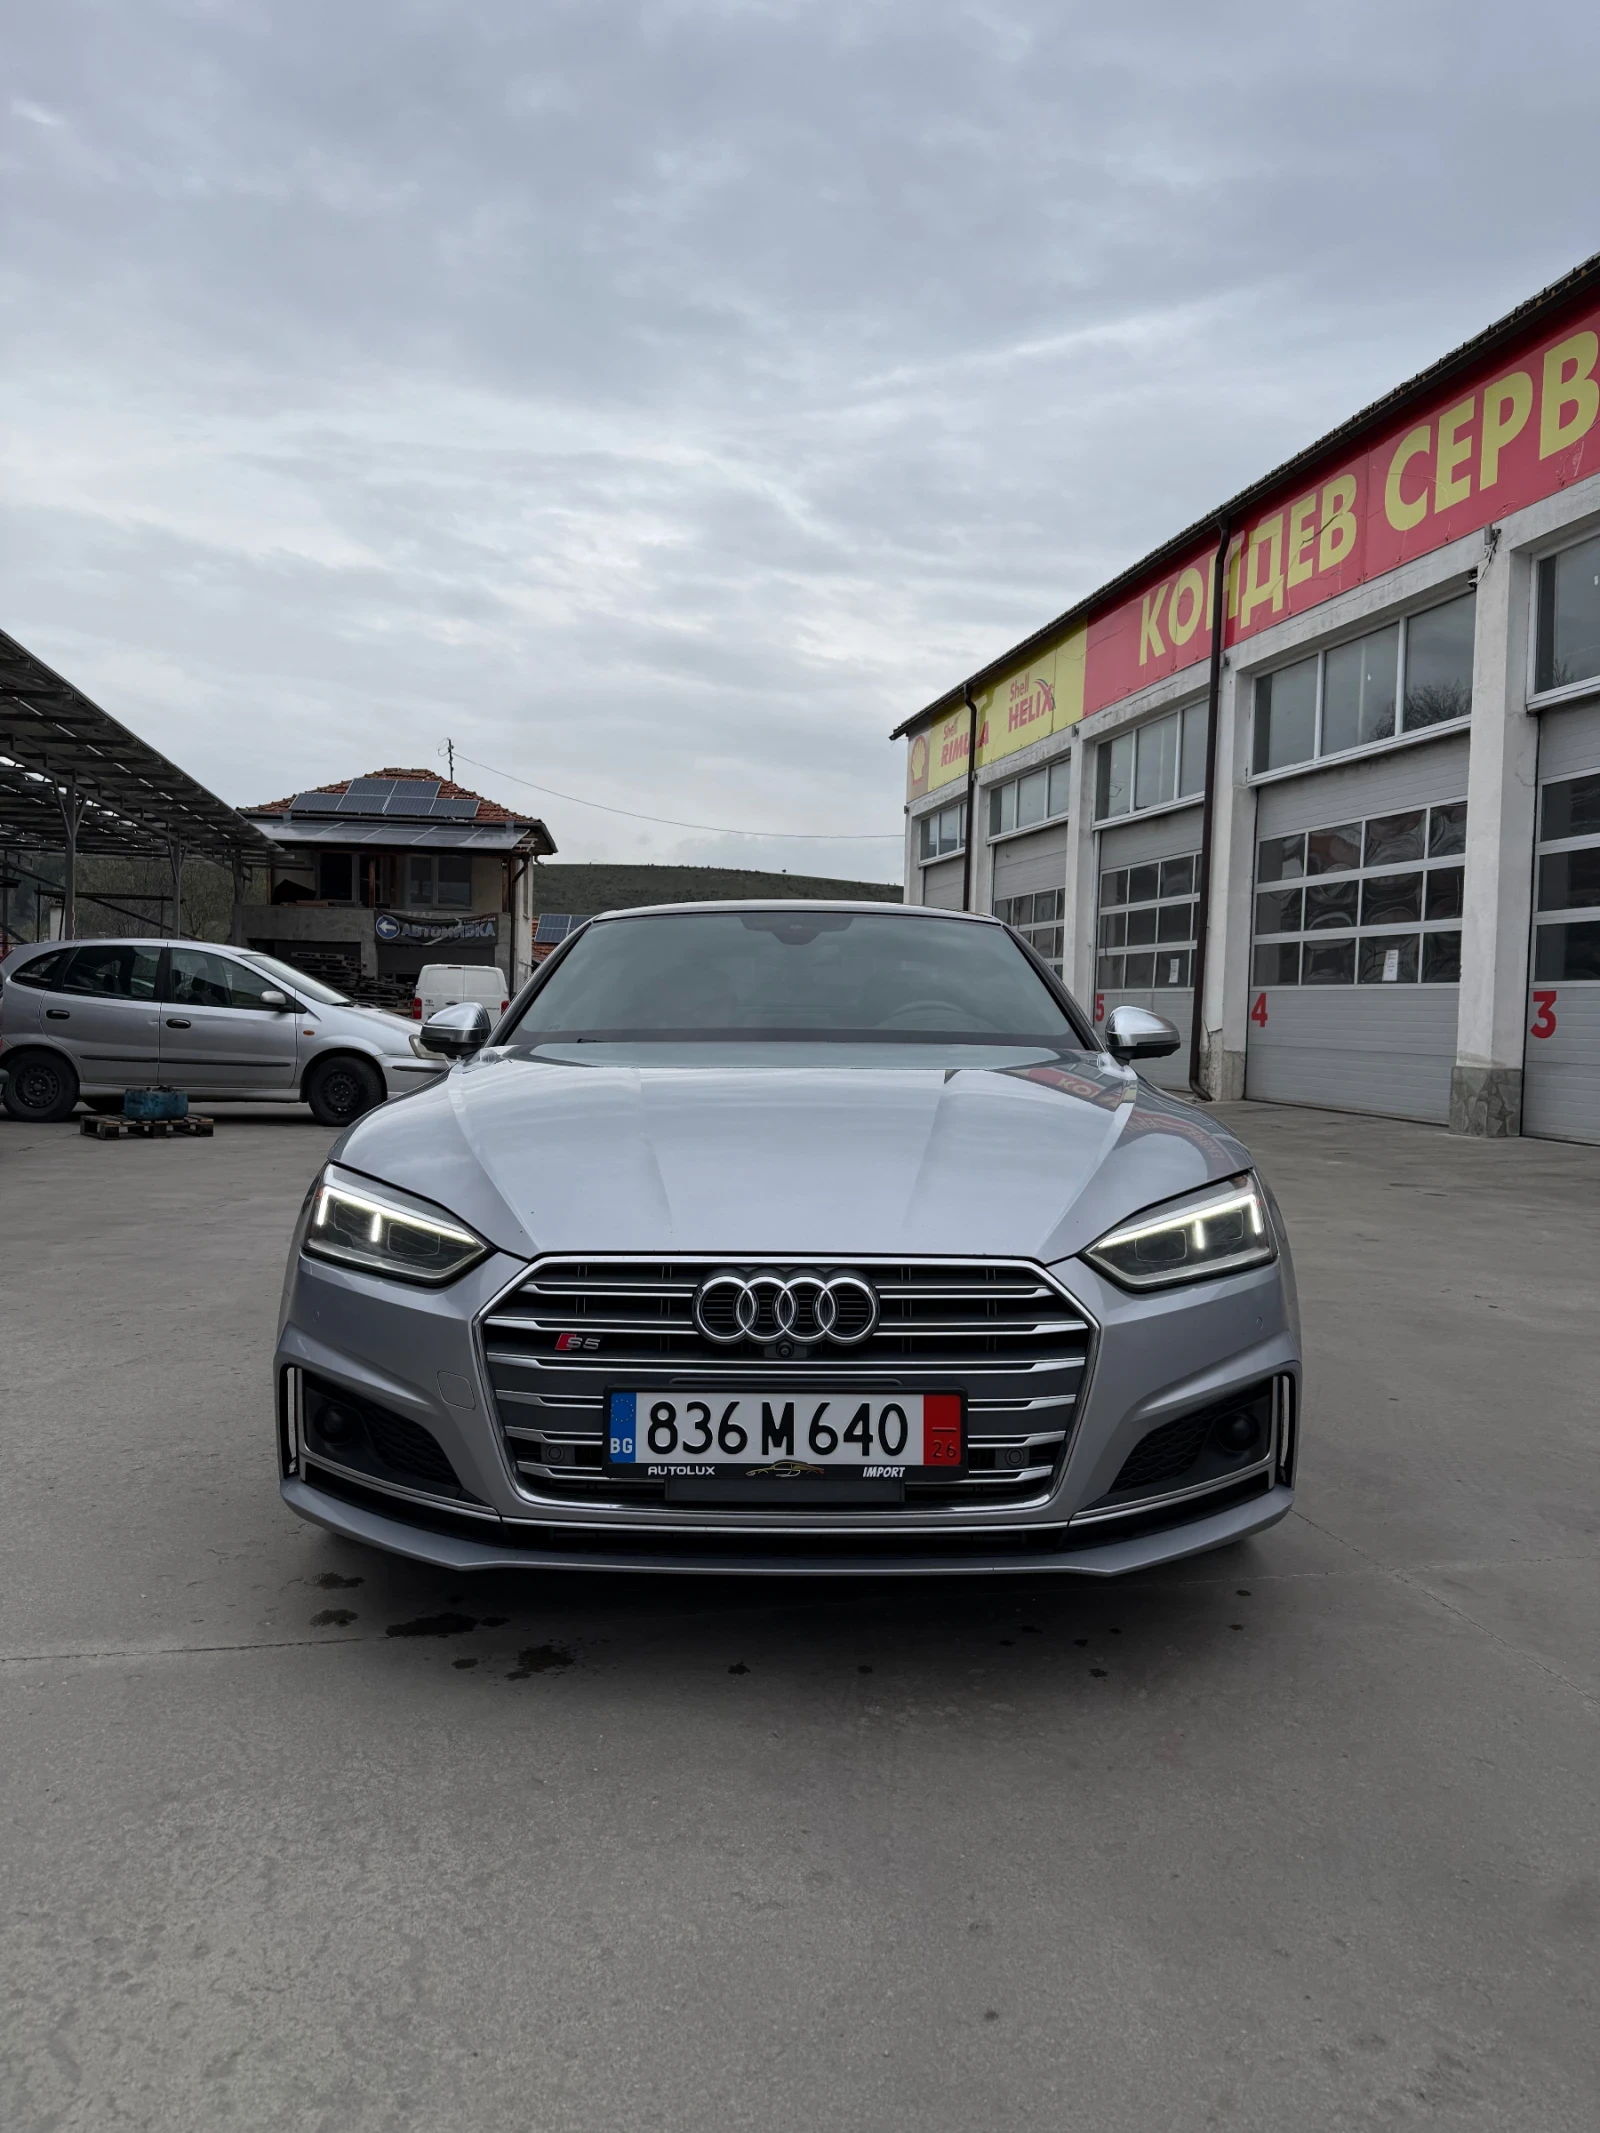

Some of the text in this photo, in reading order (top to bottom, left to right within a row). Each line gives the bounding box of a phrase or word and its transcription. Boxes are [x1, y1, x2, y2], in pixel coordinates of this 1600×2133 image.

[1139, 330, 1600, 666] КОНДЕВ СЕРВ
[1009, 672, 1030, 702] Shell
[1008, 681, 1055, 733] HELIX
[1095, 993, 1105, 1022] 5
[1251, 992, 1268, 1028] 4
[1530, 990, 1557, 1039] 3
[566, 1337, 601, 1349] S5
[647, 1401, 748, 1455] 836
[808, 1401, 908, 1456] 640
[610, 1437, 633, 1454] BG
[932, 1440, 957, 1459] 26
[647, 1465, 905, 1478] AUTOLUX IMPORT
